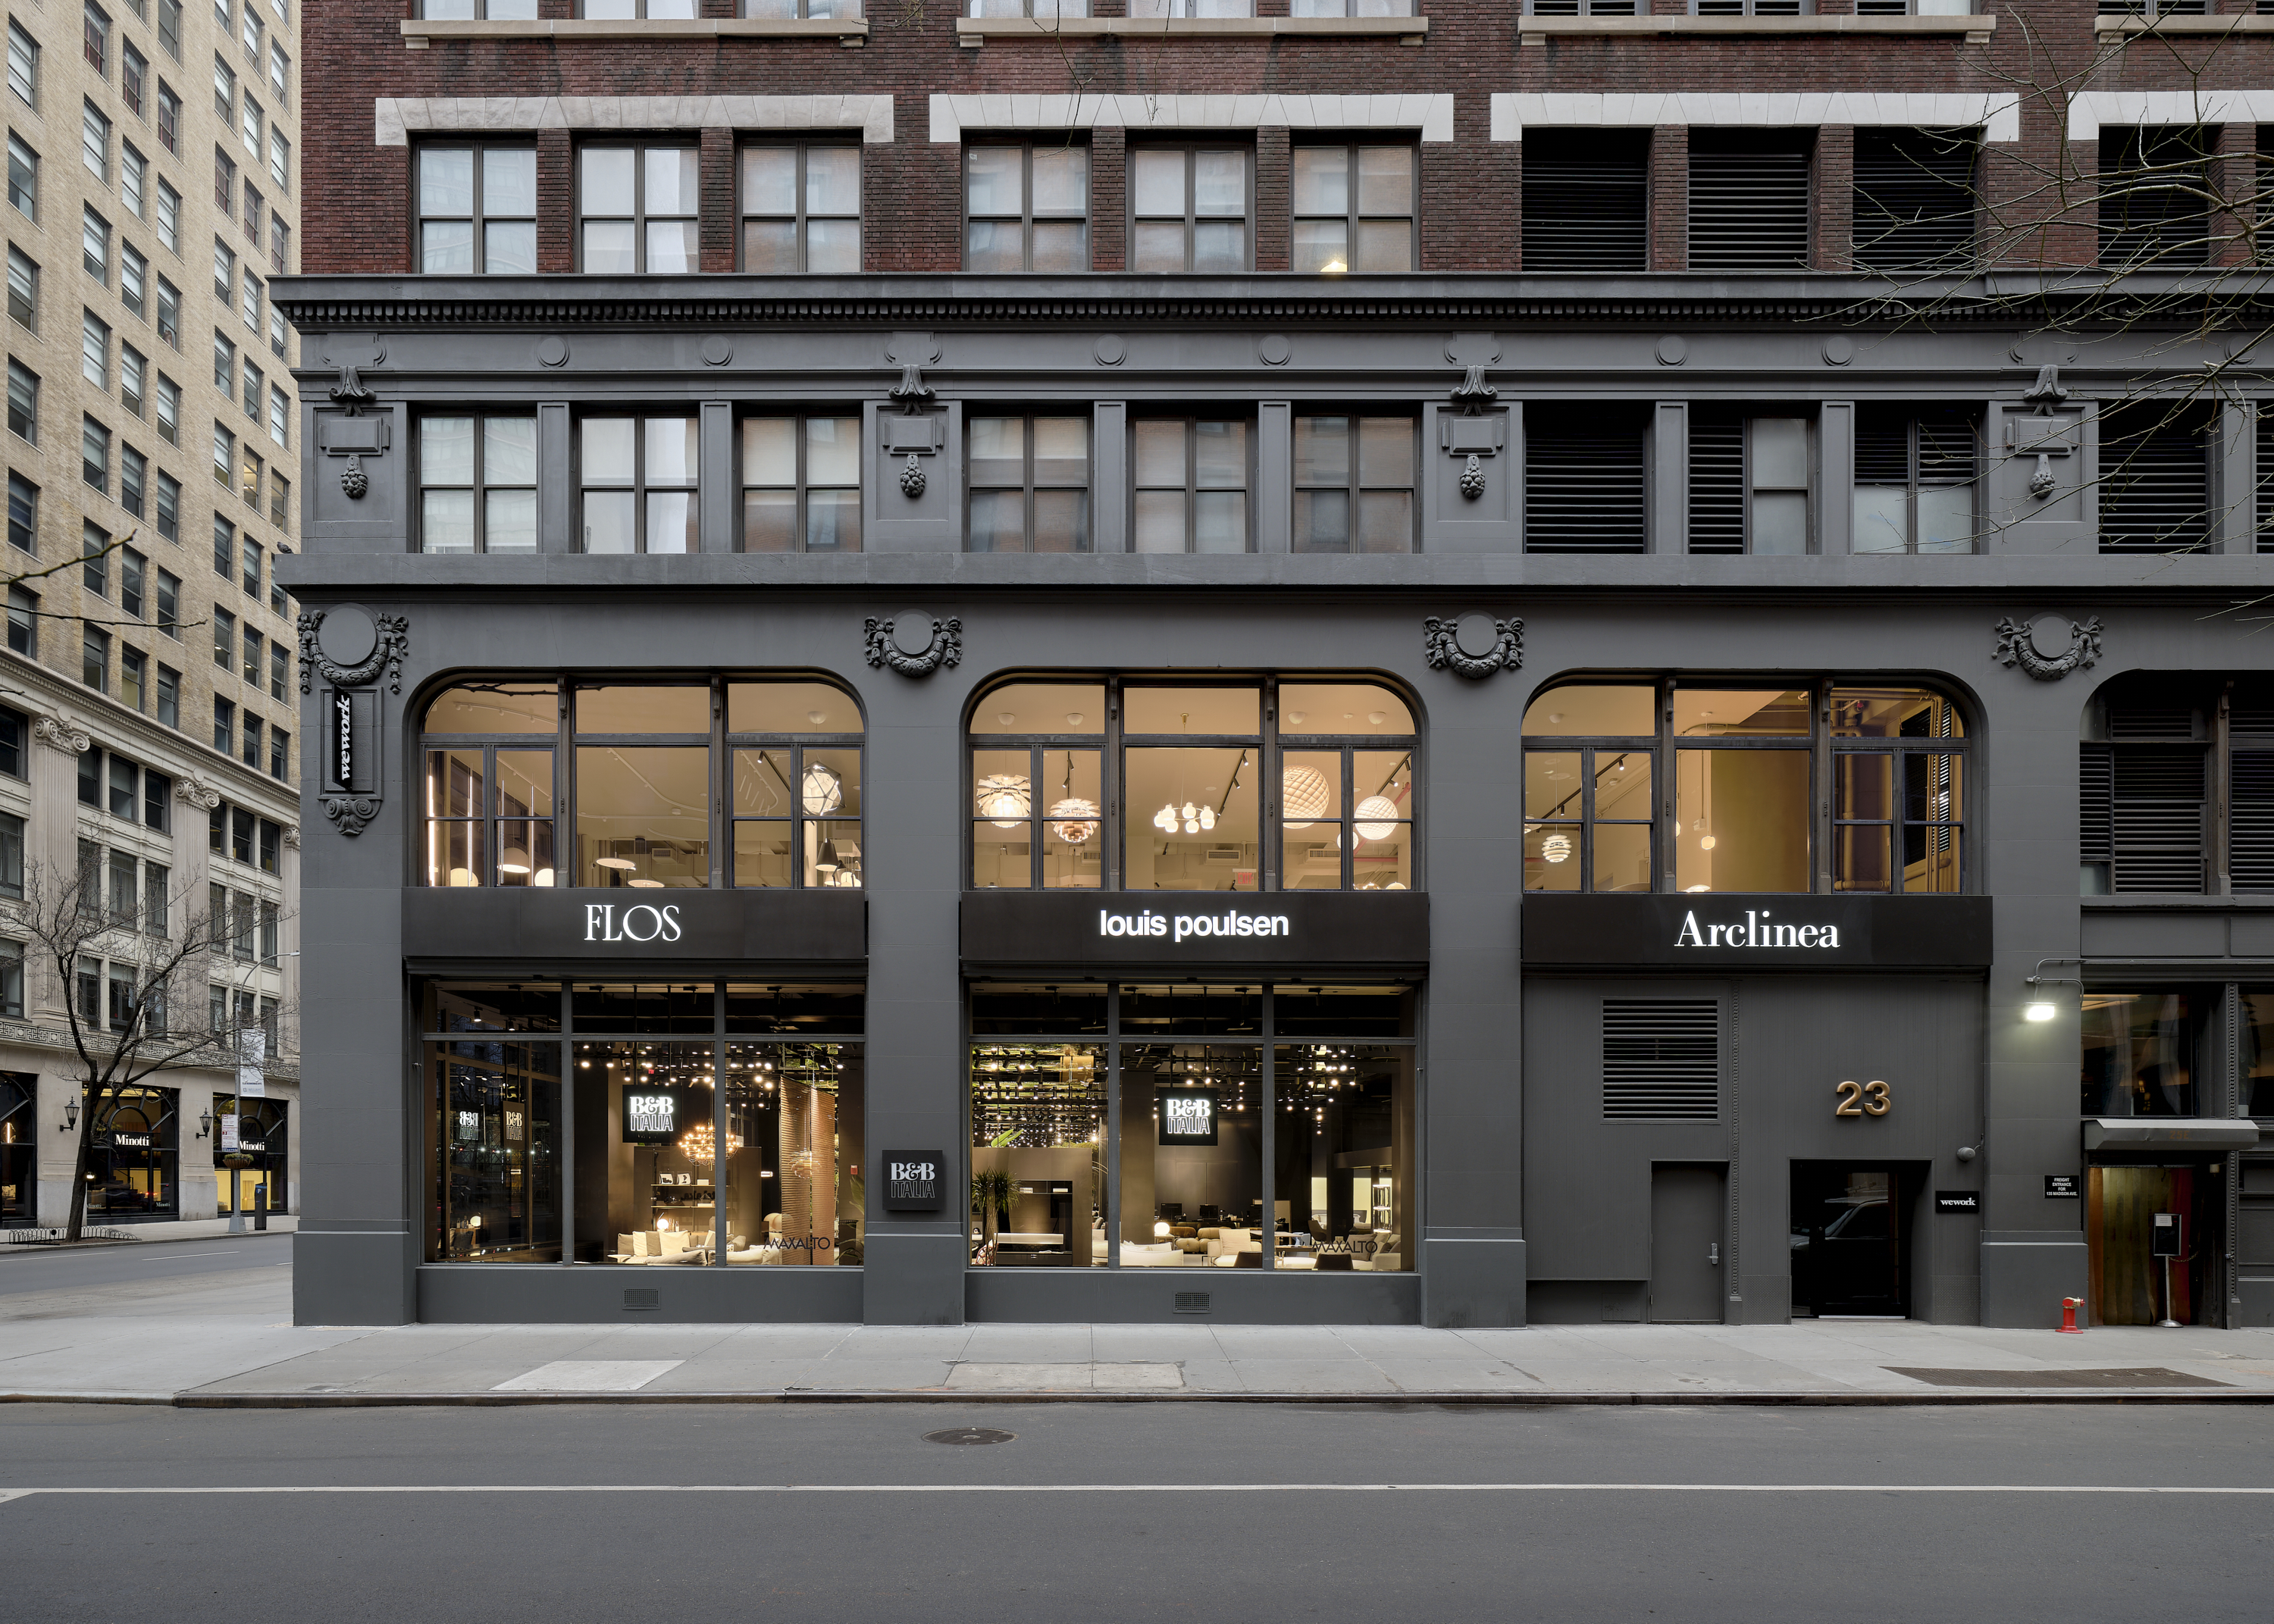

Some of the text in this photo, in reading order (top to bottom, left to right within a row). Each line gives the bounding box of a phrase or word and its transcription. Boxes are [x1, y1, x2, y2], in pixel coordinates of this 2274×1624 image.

[337, 695, 350, 781] wework
[1238, 873, 1253, 884] EXIT
[584, 904, 681, 942] FLOS
[1100, 910, 1289, 943] louis poulsen
[1674, 910, 1841, 948] Arclinea
[629, 1096, 674, 1115] B&B
[1835, 1080, 1891, 1116] 23
[1167, 1099, 1211, 1117] B&B
[506, 1111, 522, 1127] B&B
[630, 1114, 674, 1131] ITALIA
[1167, 1116, 1211, 1134] ITALIA
[115, 1134, 149, 1146] Minotti
[239, 1141, 265, 1151] Minotti
[890, 1162, 935, 1181] B&B
[891, 1181, 935, 1198] ITALIA
[1940, 1197, 1976, 1206] wework
[763, 1237, 830, 1250] MAXALTO
[1311, 1241, 1378, 1253] MAXALTO
